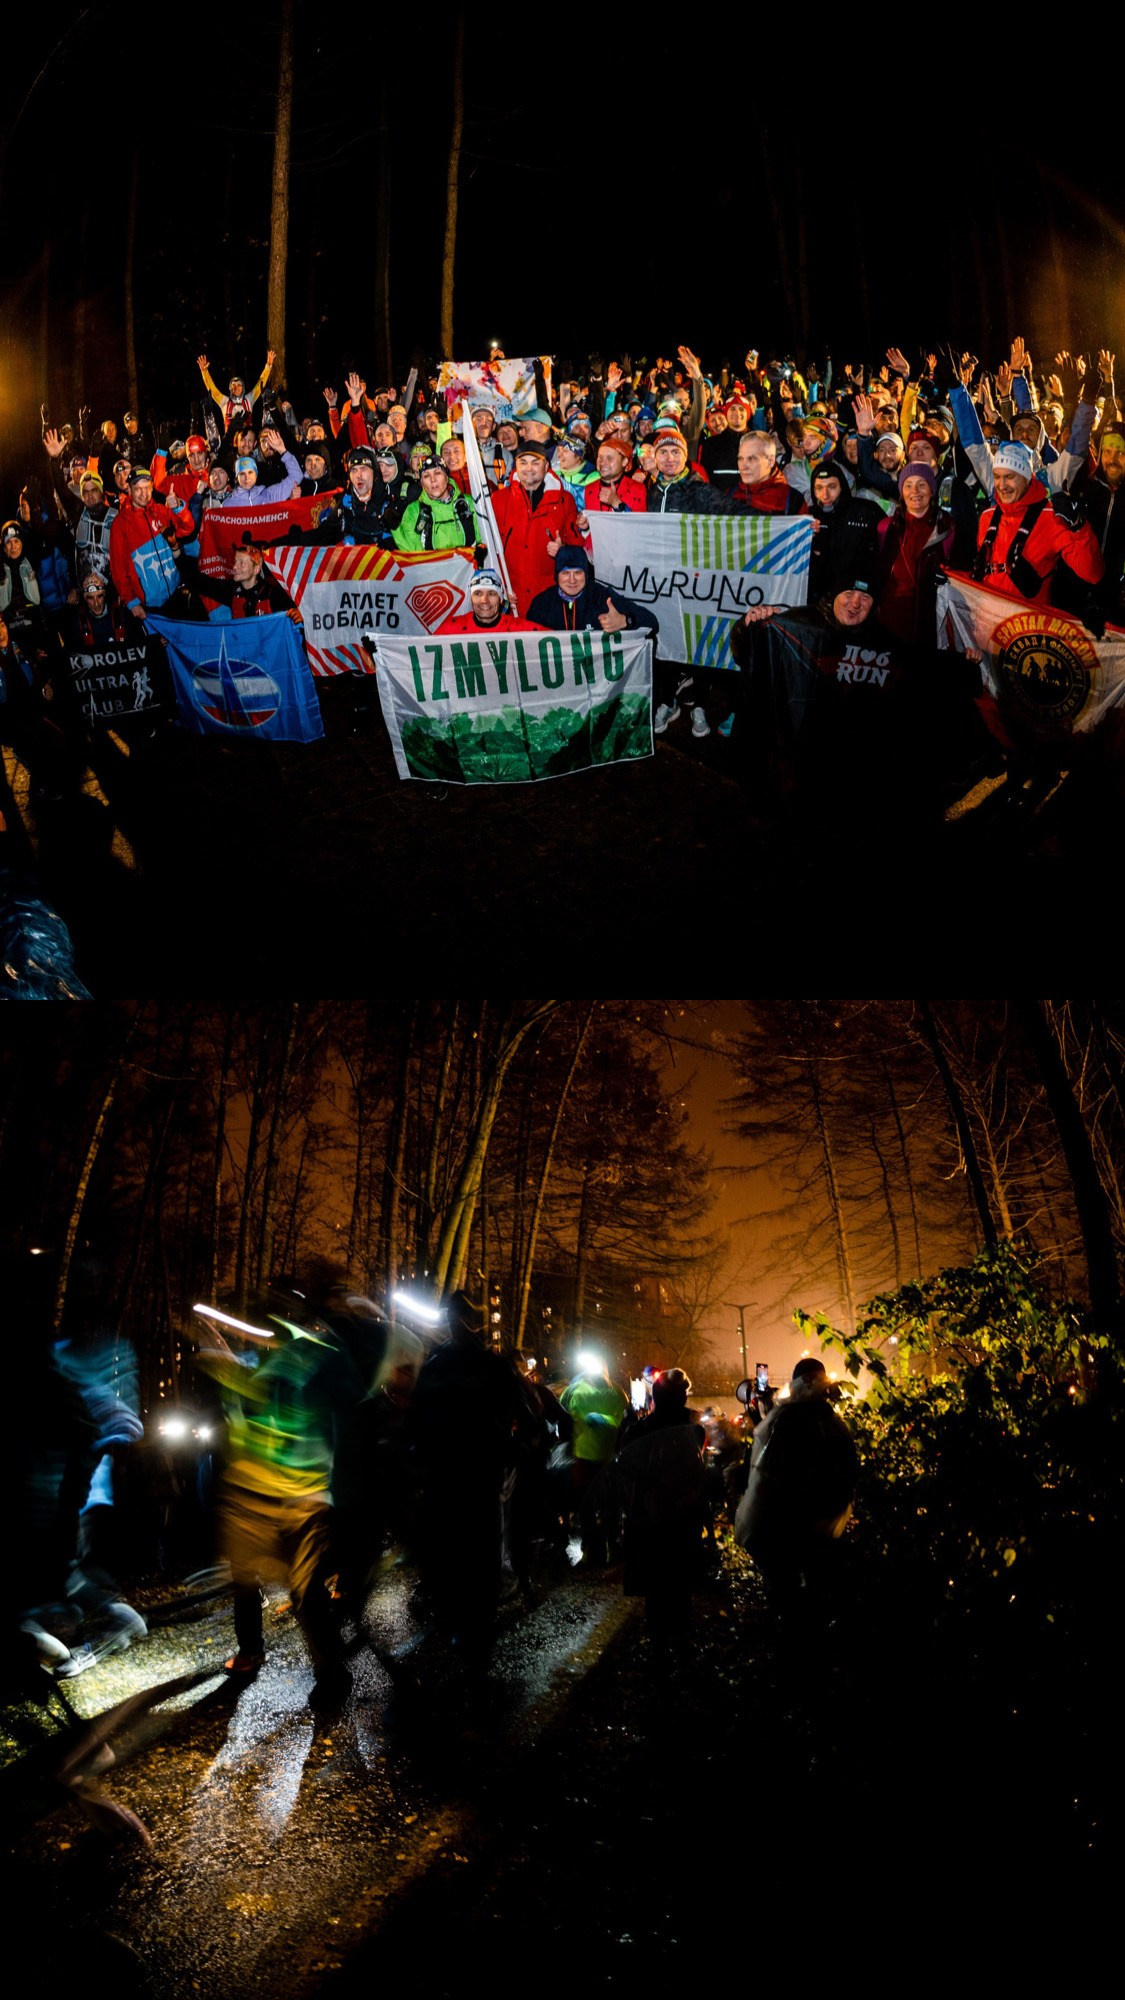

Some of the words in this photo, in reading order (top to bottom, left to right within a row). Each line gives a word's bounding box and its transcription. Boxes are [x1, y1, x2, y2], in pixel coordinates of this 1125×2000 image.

[210, 511, 289, 525] КРАСНОЗНАМЕНСК
[339, 591, 399, 611] АТЛЕТ
[996, 614, 1047, 644] SPARTAK
[1048, 615, 1096, 669] MOSCOW
[408, 631, 624, 702] IZMYLONG
[836, 662, 890, 687] RUN
[75, 674, 129, 693] ULTRA
